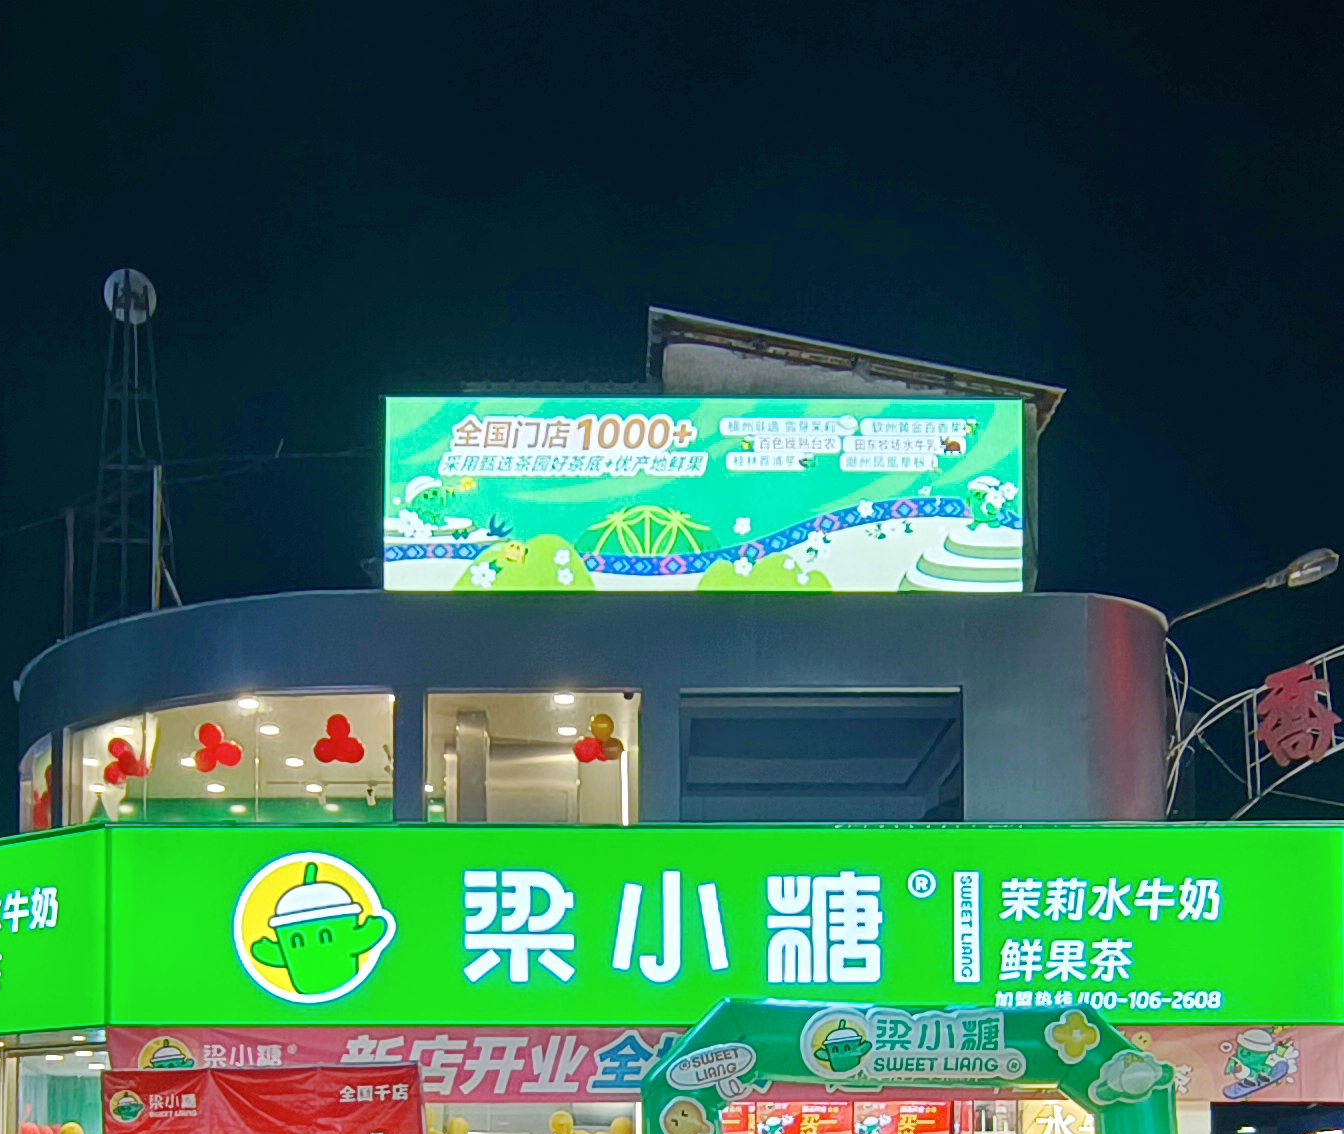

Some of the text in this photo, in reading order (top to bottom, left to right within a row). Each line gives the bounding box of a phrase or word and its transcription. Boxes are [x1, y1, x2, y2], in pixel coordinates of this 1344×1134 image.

[454, 418, 693, 450] 全国门店1000+
[1000, 876, 1222, 922] 茉莉水牛奶
[463, 870, 883, 984] 梁小糖
[960, 875, 973, 978] SWEET LIANG
[999, 938, 1133, 983] 鲜果茶
[995, 990, 1073, 1008] 加盟热线
[874, 1018, 1000, 1052] 梁小糖
[204, 1031, 684, 1095] 梁小糖 店开业全
[691, 1047, 739, 1068] SWEET
[696, 1062, 737, 1083] LIANG
[873, 1057, 999, 1073] SWEET LIANG
[339, 1084, 409, 1103] 全国千店
